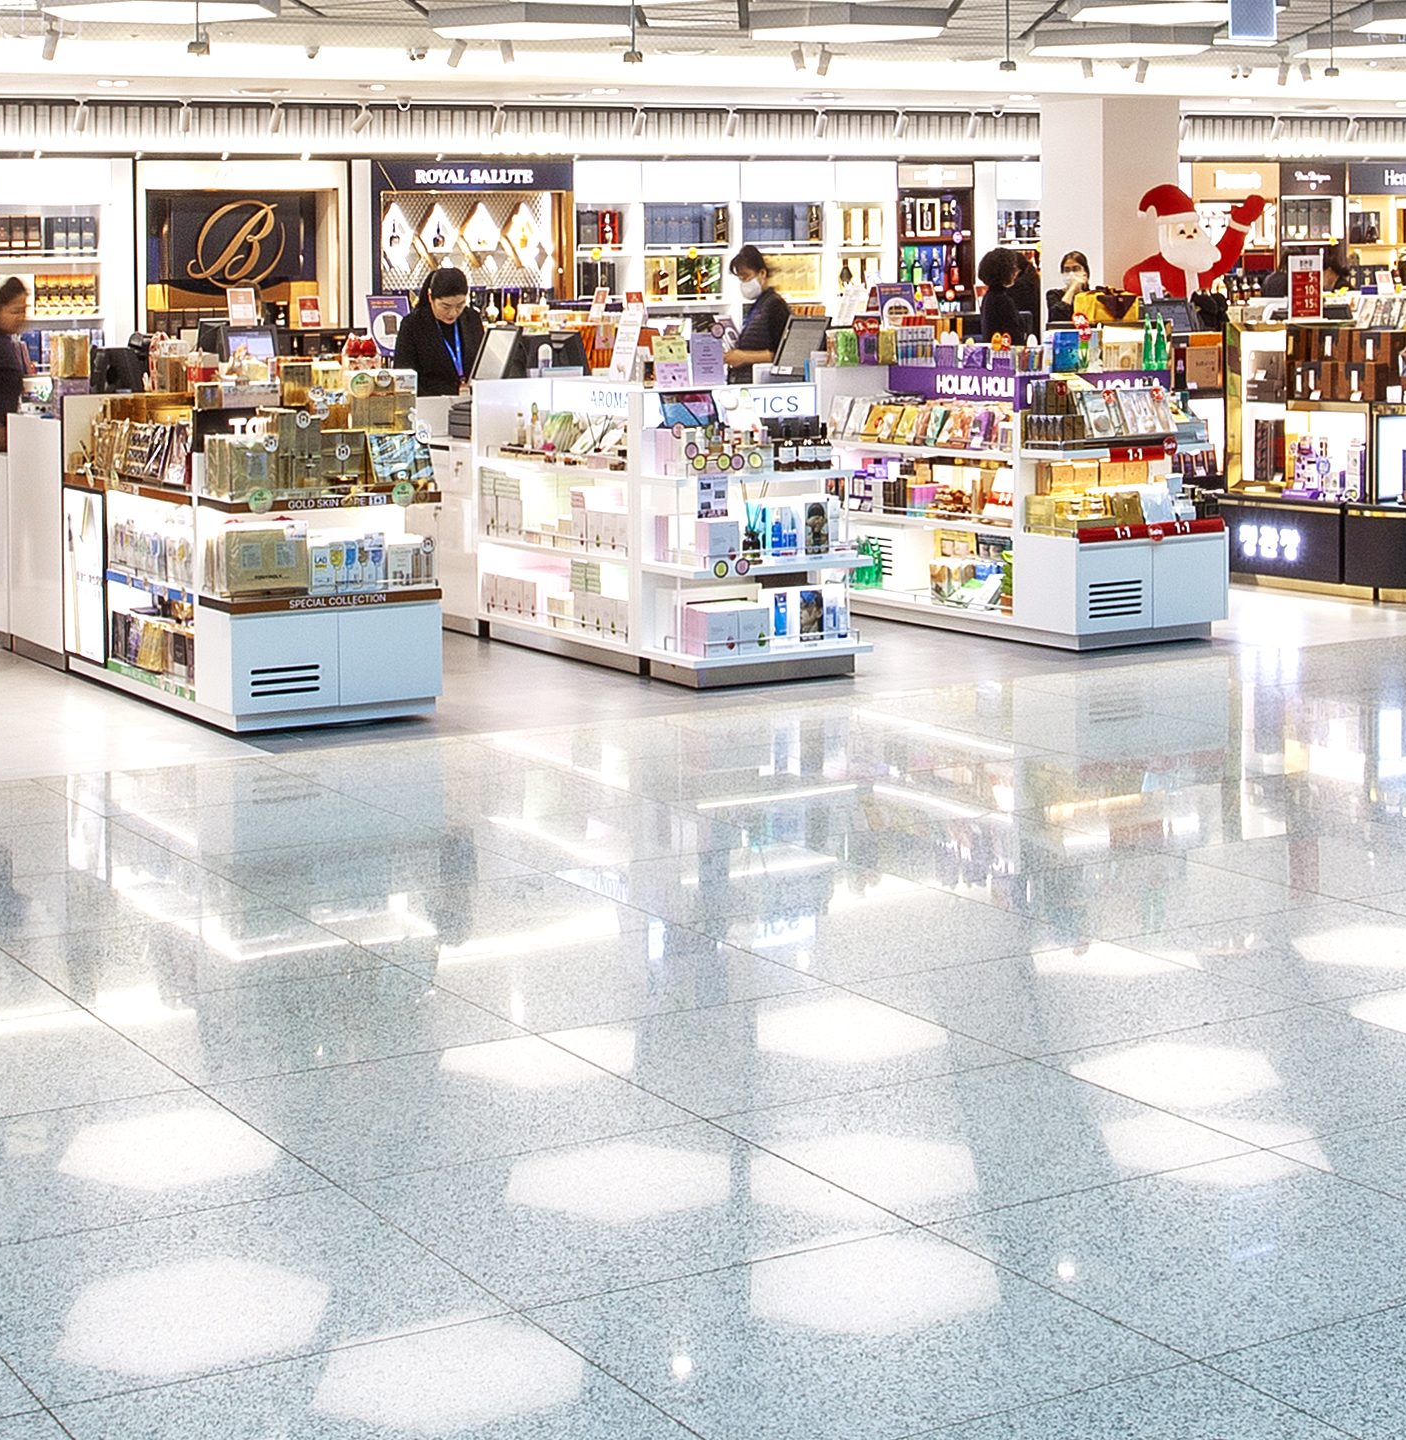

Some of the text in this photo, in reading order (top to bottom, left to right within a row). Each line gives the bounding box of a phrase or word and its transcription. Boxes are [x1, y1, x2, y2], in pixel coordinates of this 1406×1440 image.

[414, 168, 535, 185] ROYAL SALUTE
[936, 374, 981, 397] HOLIKA
[288, 499, 316, 510] GOLD
[316, 497, 340, 509] SKIN
[289, 594, 387, 609] SPECIAL COLLECTION
